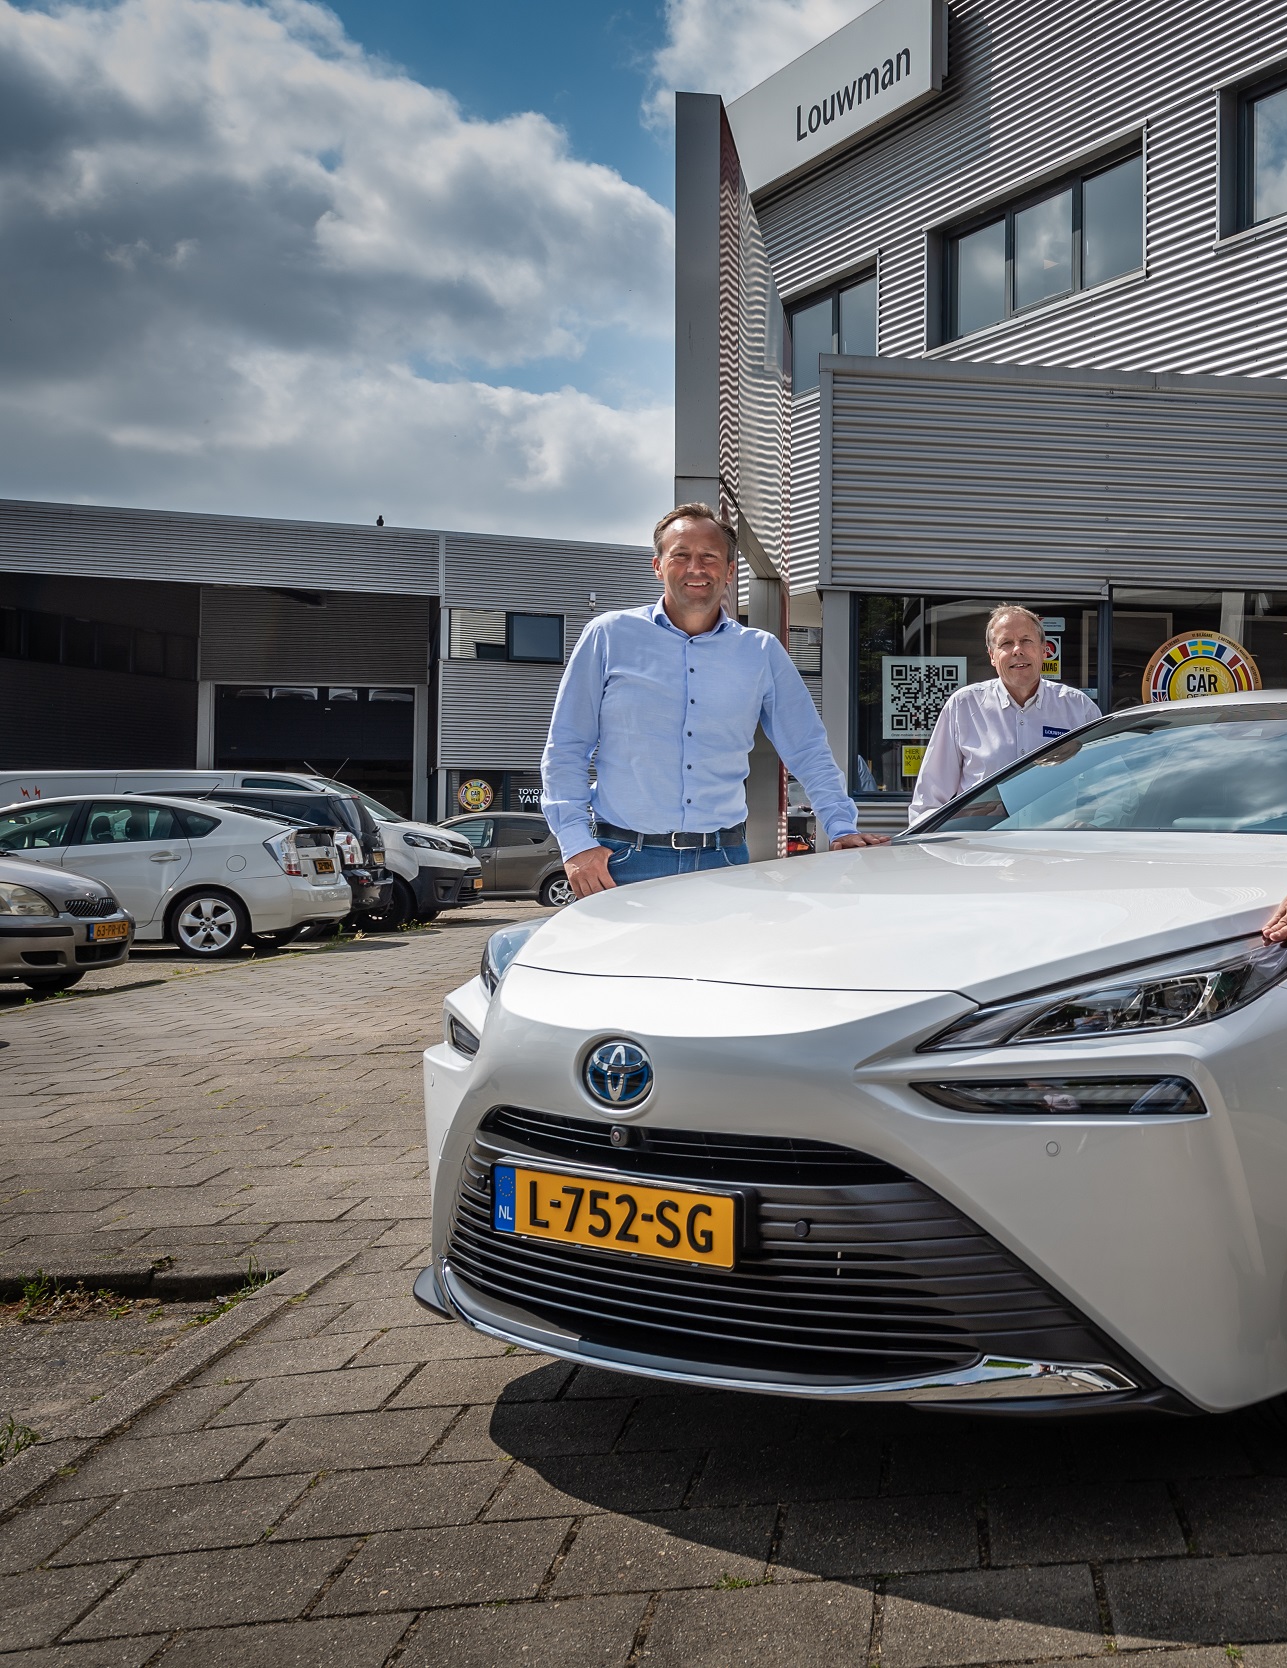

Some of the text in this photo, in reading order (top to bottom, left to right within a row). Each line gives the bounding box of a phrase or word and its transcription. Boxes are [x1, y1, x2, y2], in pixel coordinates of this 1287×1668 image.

[796, 47, 911, 142] Louwman
[1042, 662, 1058, 672] OVAG
[1186, 673, 1218, 693] CAR
[518, 795, 540, 804] YAR
[96, 923, 126, 937] 63-PR-KS
[498, 1180, 713, 1253] NL L-752-SG
